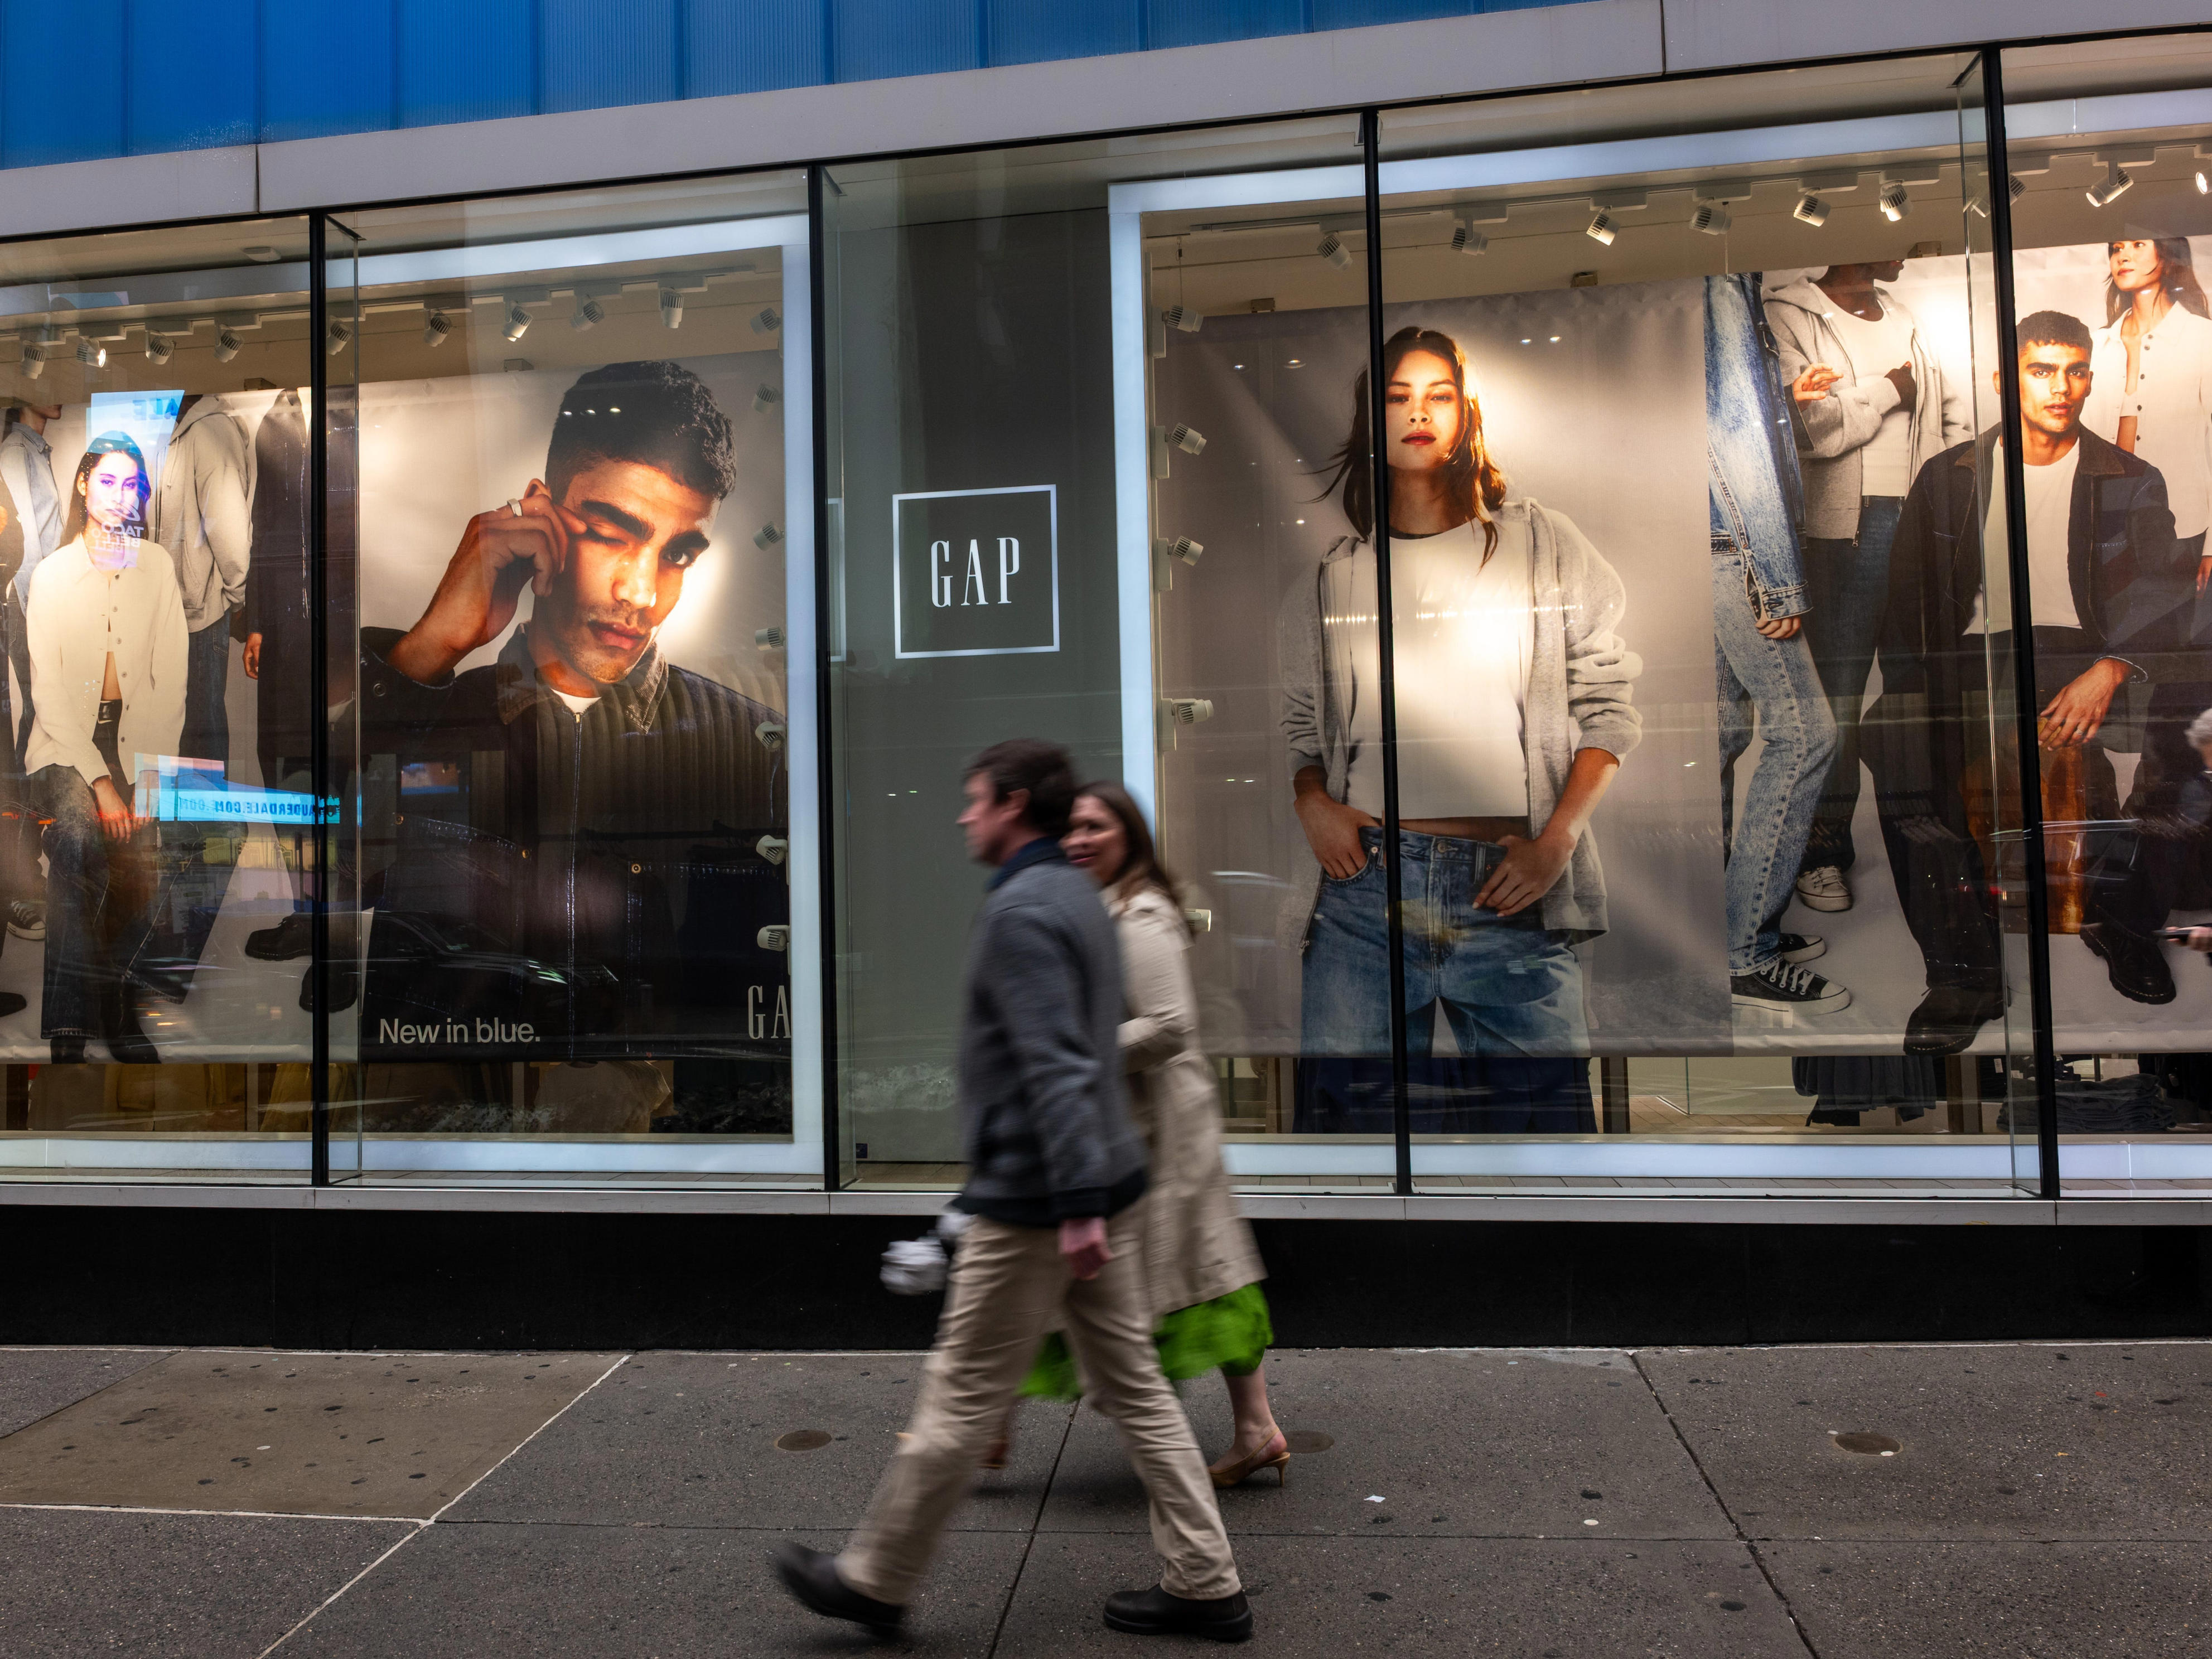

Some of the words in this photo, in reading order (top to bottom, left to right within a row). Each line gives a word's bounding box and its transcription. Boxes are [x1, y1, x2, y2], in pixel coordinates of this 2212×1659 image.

[930, 536, 1020, 608] GAP
[379, 1018, 440, 1044] New
[447, 1018, 469, 1043] in
[476, 1017, 541, 1043] blue.
[747, 985, 791, 1040] GA
